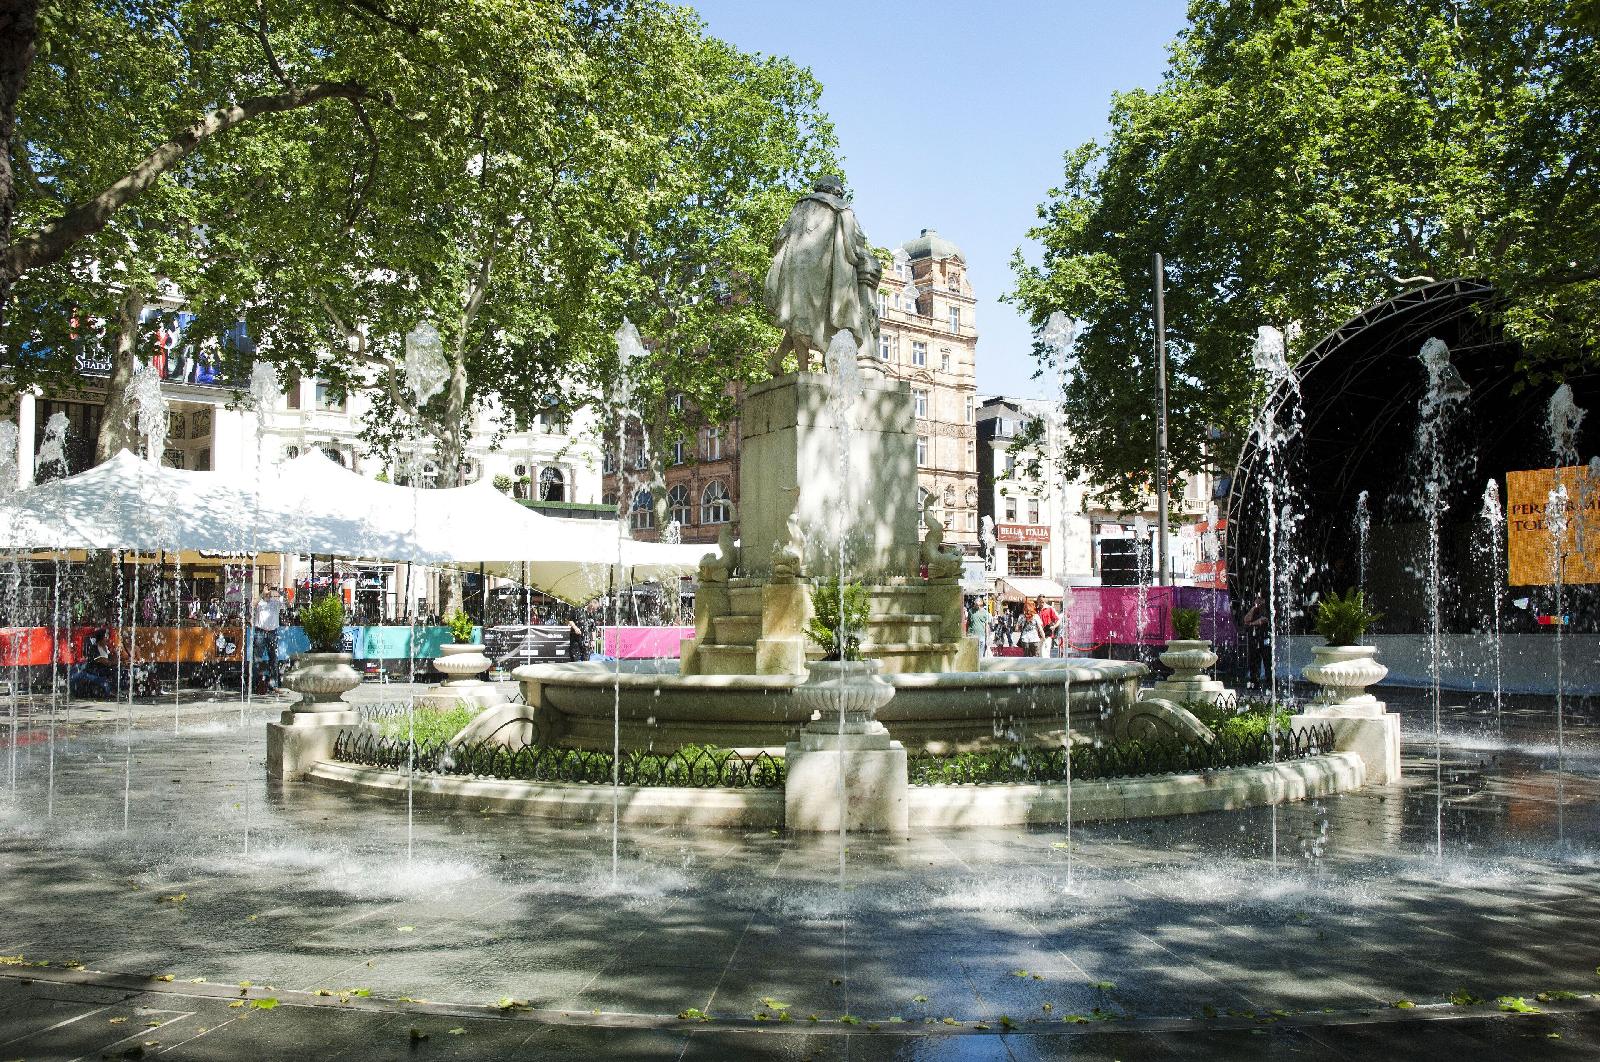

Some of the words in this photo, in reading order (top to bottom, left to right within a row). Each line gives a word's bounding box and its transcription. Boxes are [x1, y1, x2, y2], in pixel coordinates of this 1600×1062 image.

[1512, 518, 1573, 532] TODY
[1000, 526, 1023, 536] BELLA
[1025, 527, 1049, 538] ITALIA
